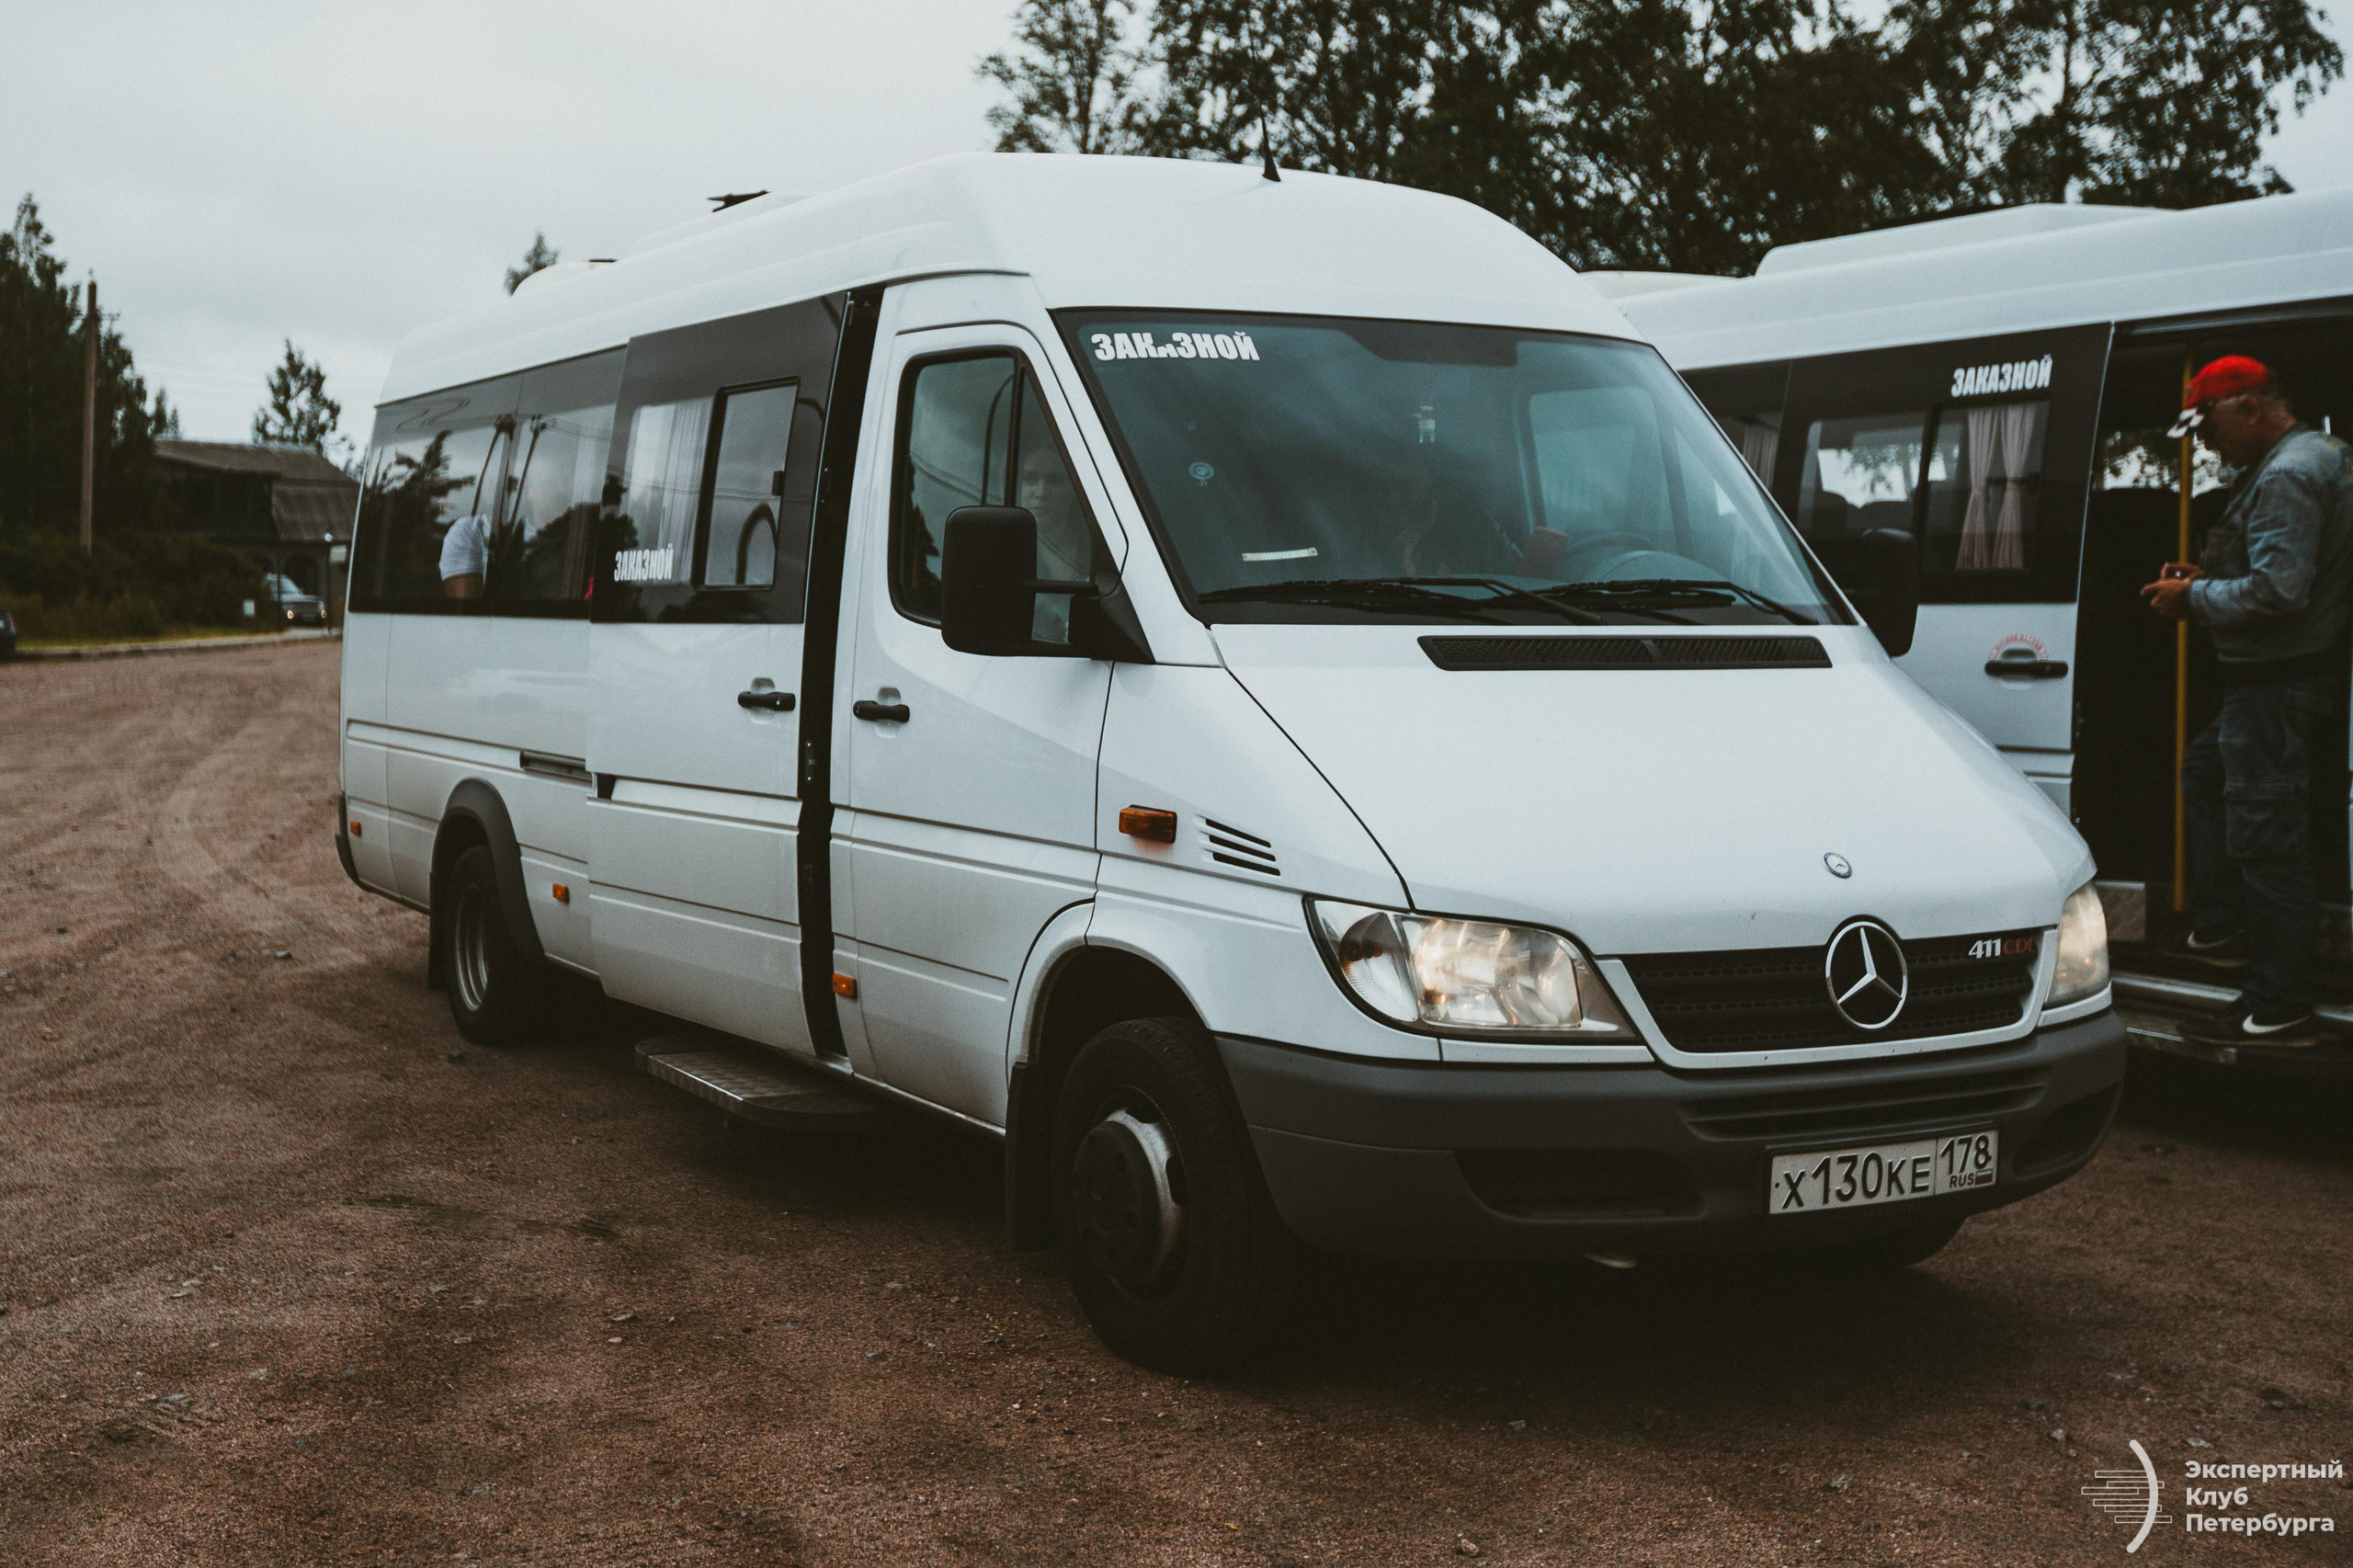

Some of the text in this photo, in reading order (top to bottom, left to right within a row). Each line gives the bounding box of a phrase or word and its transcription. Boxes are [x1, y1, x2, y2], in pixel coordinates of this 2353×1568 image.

[1950, 354, 2053, 398] ЗАКАЗНОЙ
[614, 543, 674, 582] ЗАКАЗНОЙ
[1940, 1134, 1992, 1176] 178
[1949, 1171, 1975, 1189] RUS
